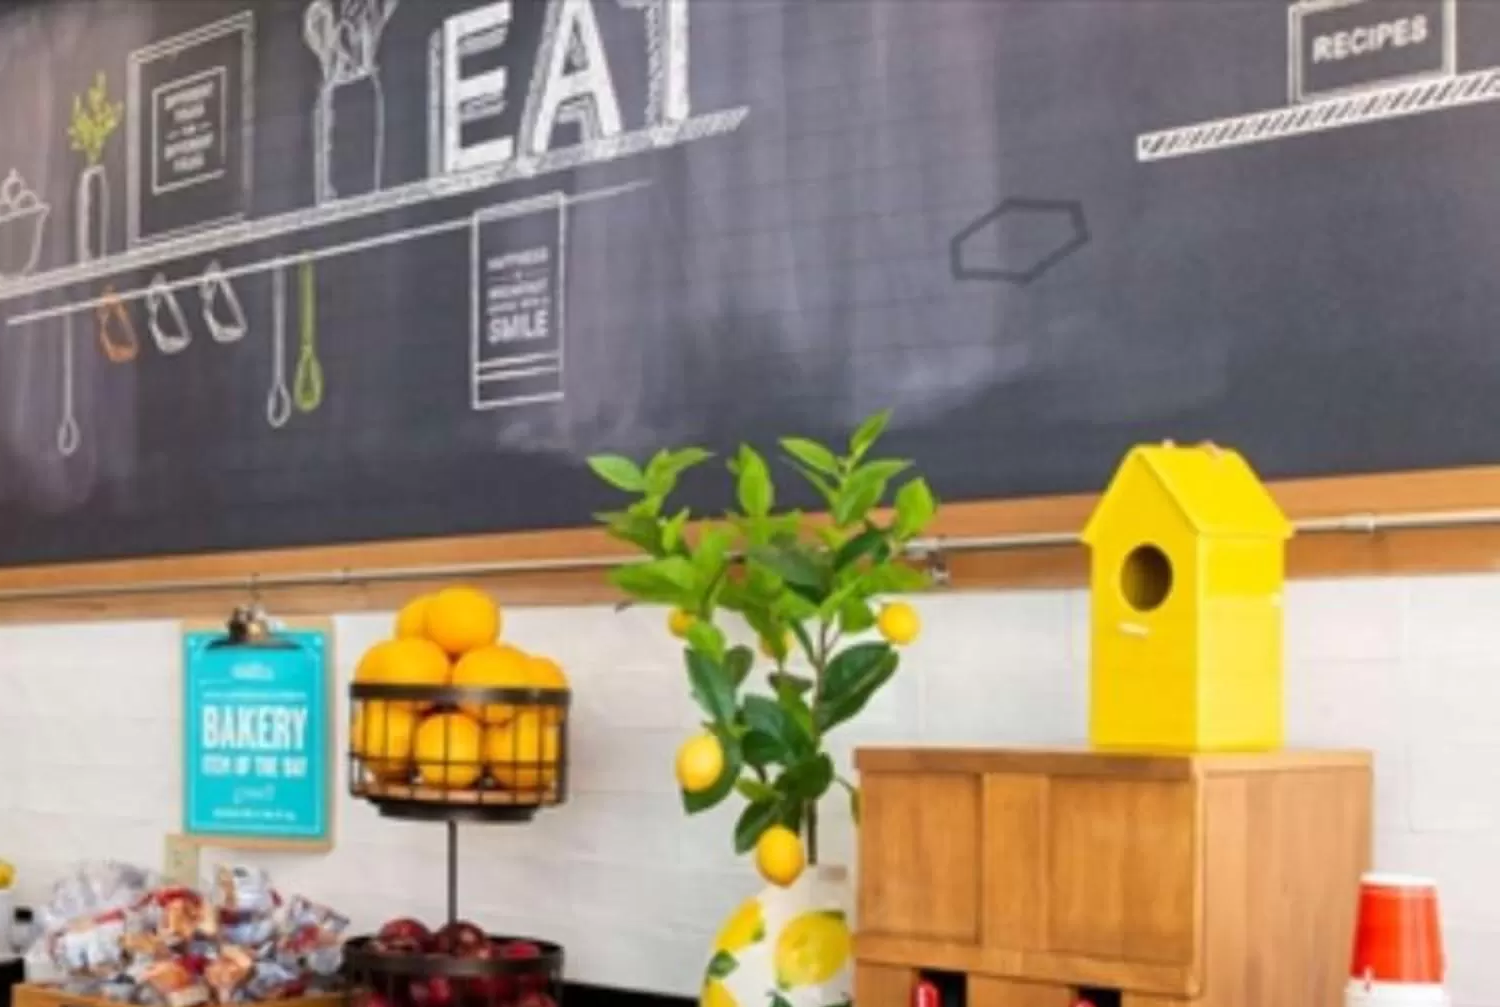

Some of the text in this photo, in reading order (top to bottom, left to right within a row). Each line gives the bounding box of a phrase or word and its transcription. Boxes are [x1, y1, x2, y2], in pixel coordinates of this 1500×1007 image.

[1312, 14, 1428, 63] RECIPES
[428, 0, 691, 178] EAT
[486, 308, 549, 345] SMILE
[202, 703, 308, 750] BAKERY
